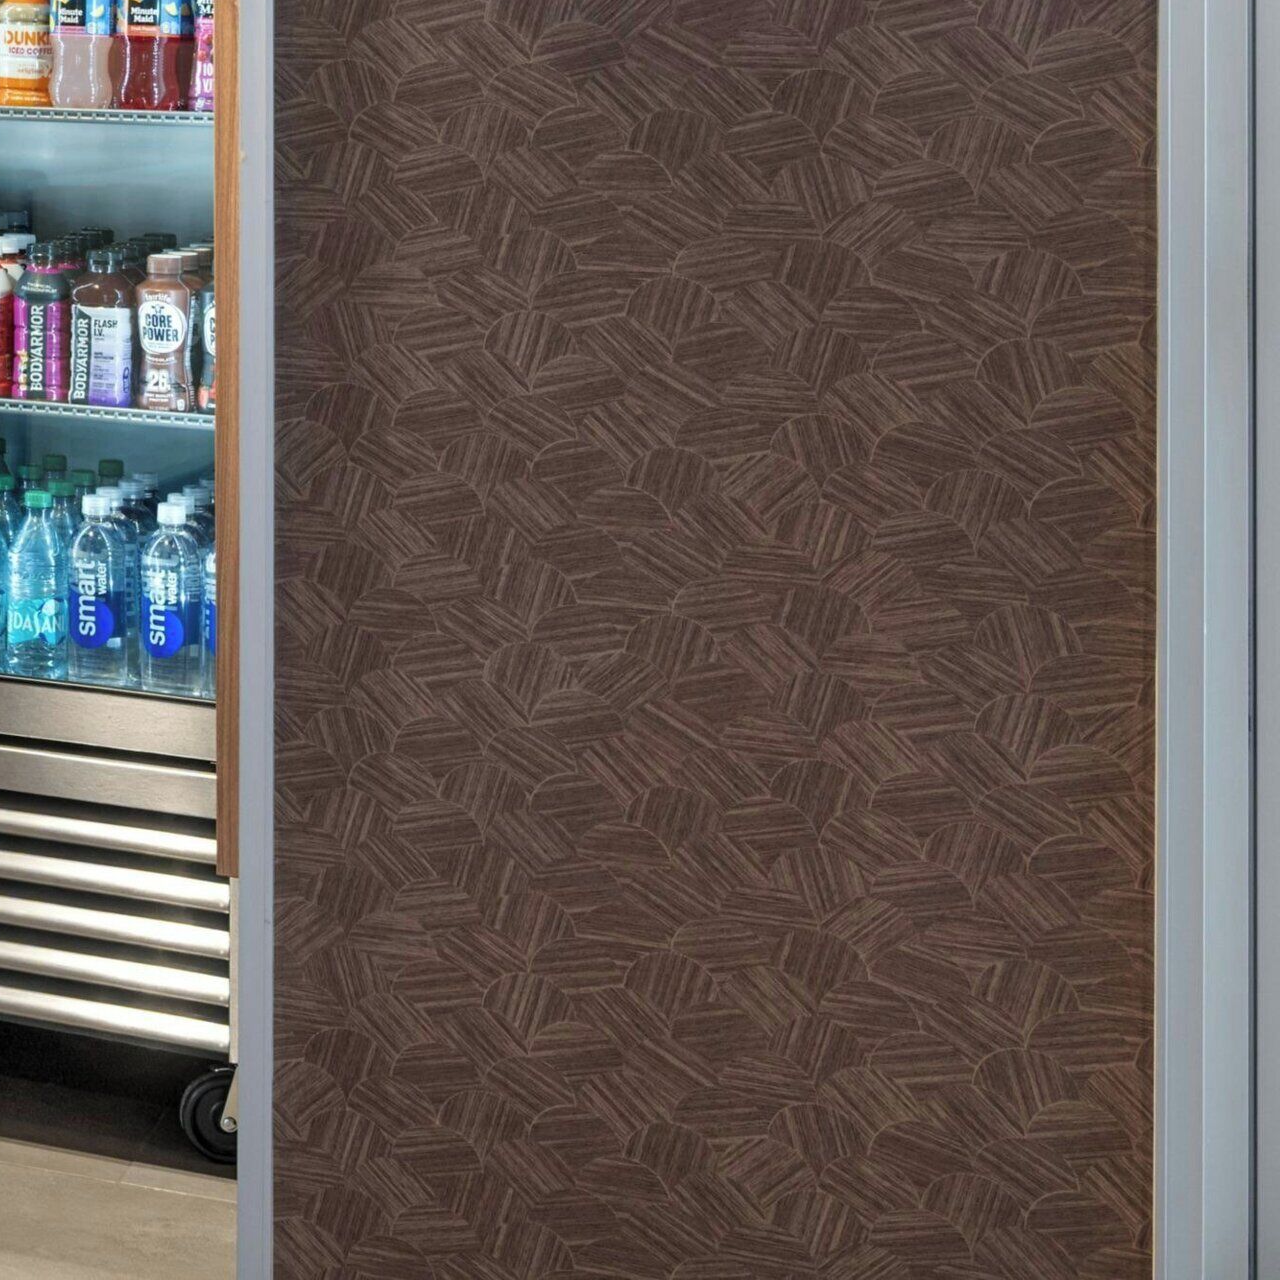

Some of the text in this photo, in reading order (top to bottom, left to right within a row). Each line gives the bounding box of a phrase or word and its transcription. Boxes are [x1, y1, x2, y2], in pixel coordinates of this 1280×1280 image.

[130, 7, 158, 16] Minute
[134, 15, 154, 24] Maid
[9, 47, 25, 55] ICED
[93, 319, 118, 329] FLASH
[143, 324, 179, 342] POWER
[145, 314, 172, 327] CORE
[30, 304, 44, 392] BODYARMOR
[72, 317, 89, 400] BODYARMOR
[98, 561, 108, 596] water
[167, 570, 179, 605] water
[78, 558, 96, 637] smart
[149, 568, 166, 646] smart
